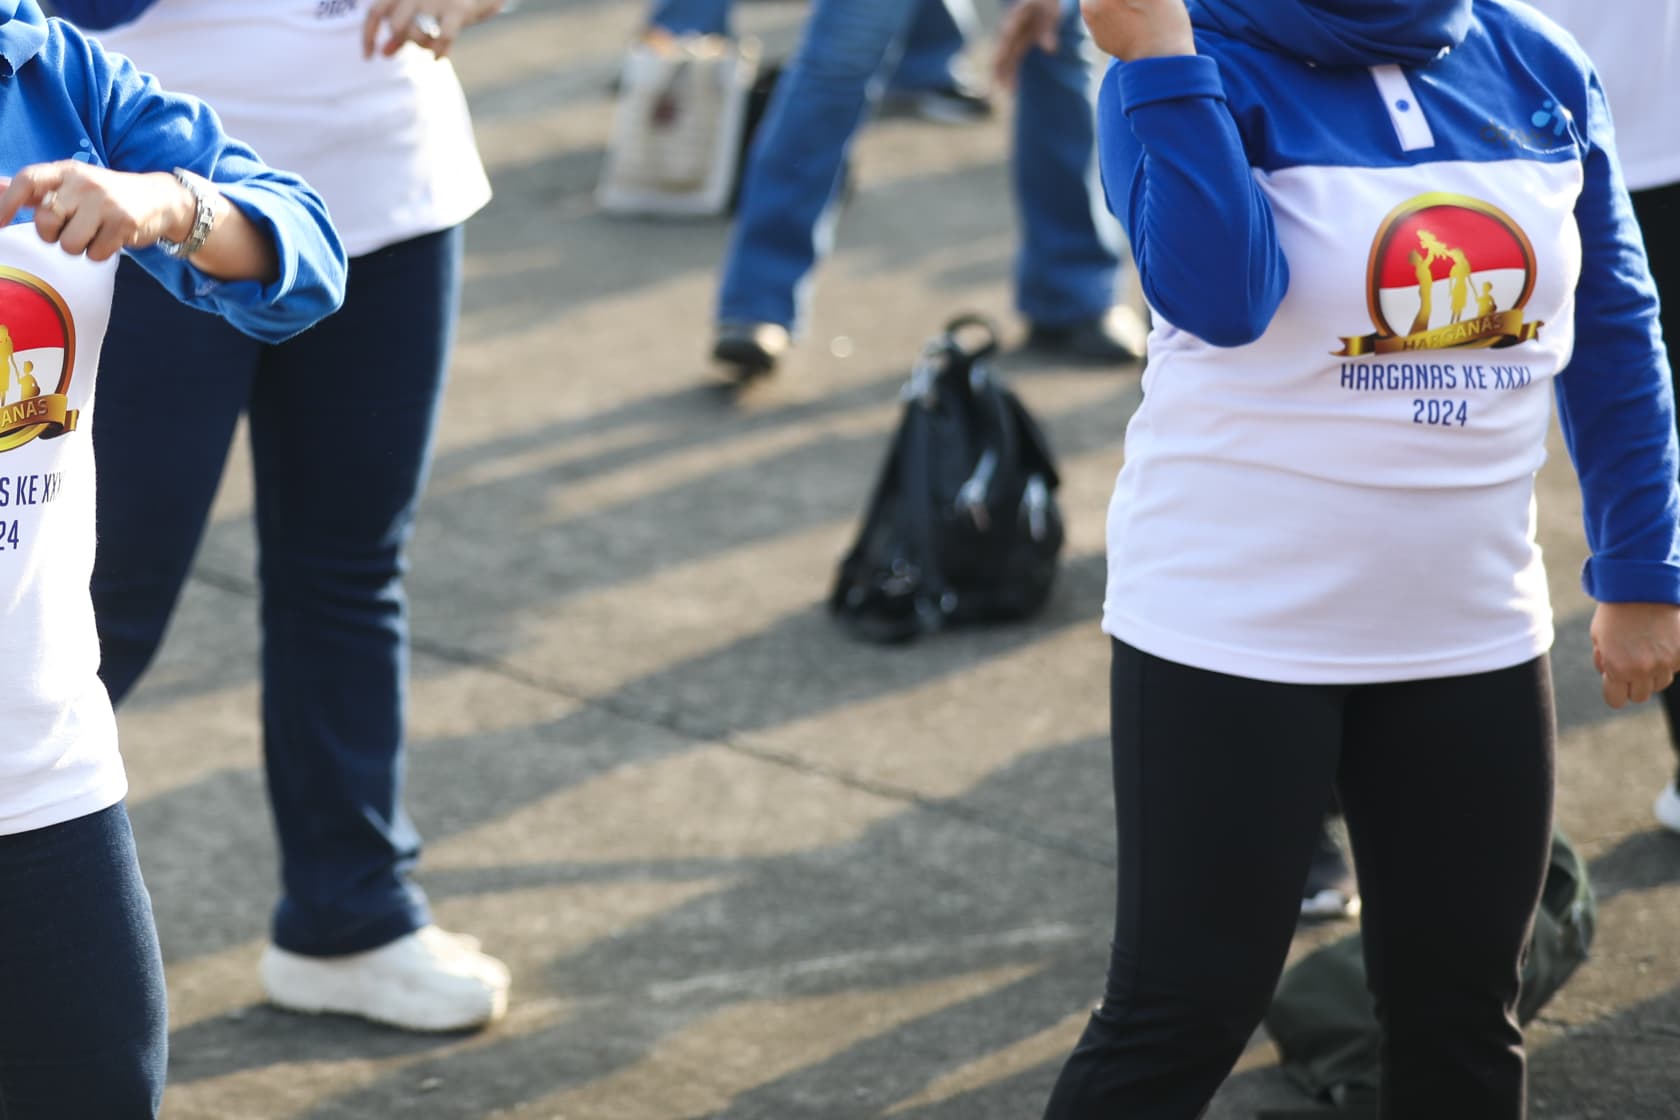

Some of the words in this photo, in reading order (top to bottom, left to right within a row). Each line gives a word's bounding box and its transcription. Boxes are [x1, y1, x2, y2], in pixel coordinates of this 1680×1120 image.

[1402, 314, 1503, 351] HARGANAS
[1340, 363, 1457, 391] HARGANAS
[1463, 364, 1488, 390] KE
[1490, 365, 1531, 390] XXXI
[1413, 399, 1467, 427] 2024
[16, 474, 39, 506] KE
